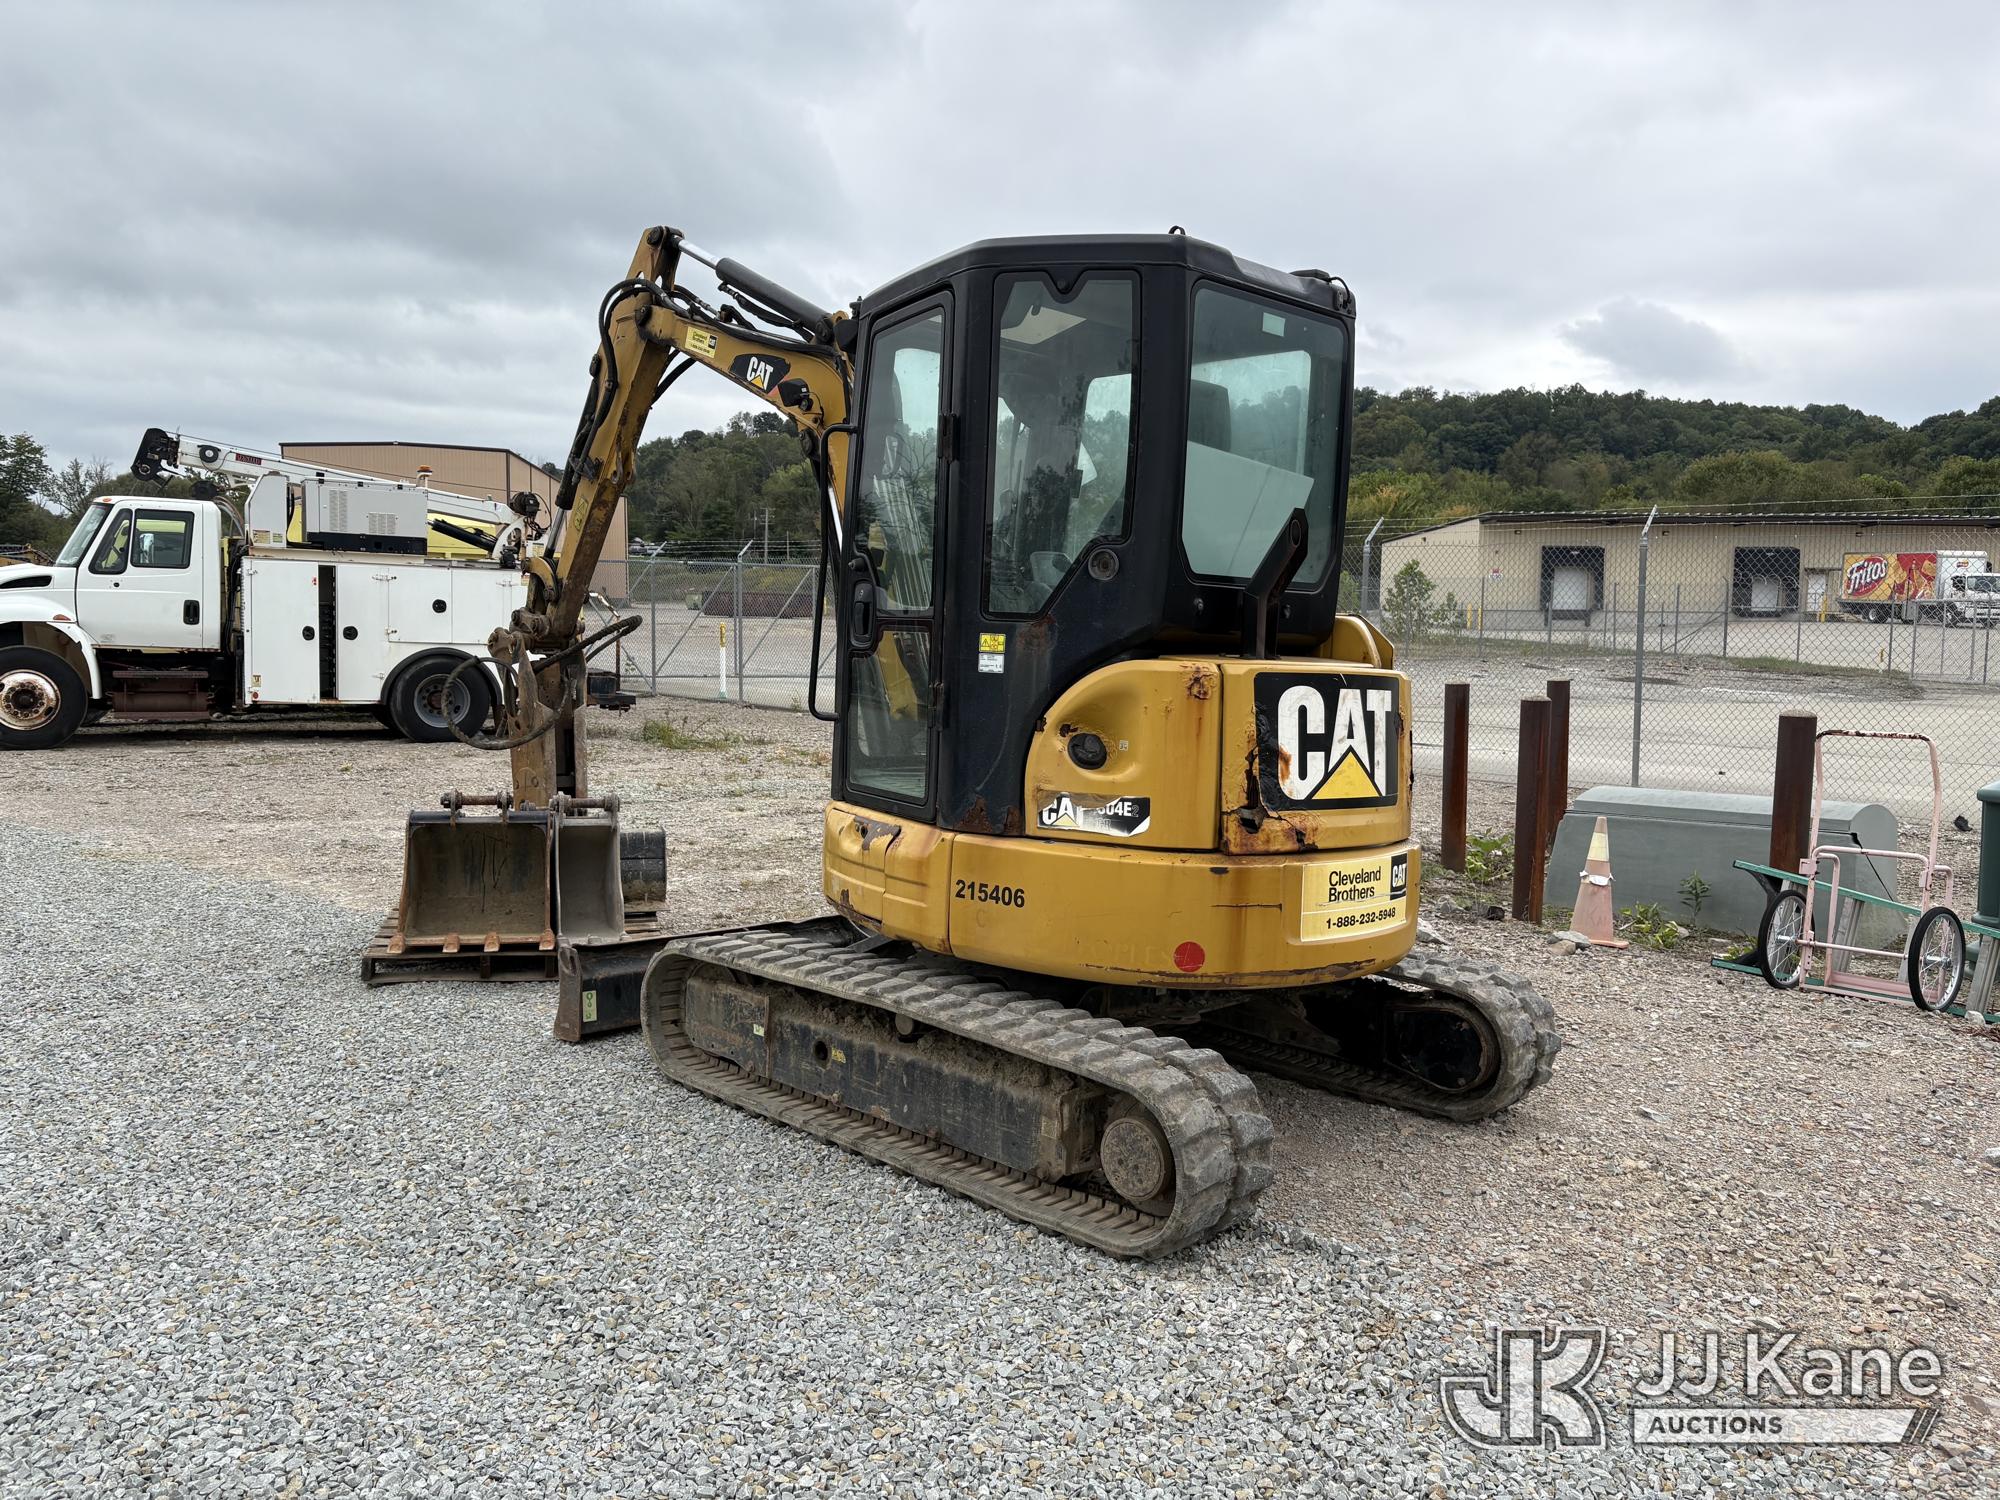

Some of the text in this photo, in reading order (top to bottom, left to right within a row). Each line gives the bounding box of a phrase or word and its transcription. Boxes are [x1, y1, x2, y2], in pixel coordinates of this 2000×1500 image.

[746, 356, 774, 390] CAT
[1846, 559, 1888, 594] Fritos
[1277, 685, 1392, 800] CAT
[1329, 866, 1382, 887] Cleveland
[1392, 863, 1407, 888] CAT
[955, 879, 1025, 908] 215406
[1328, 885, 1375, 903] Brothers
[1326, 907, 1396, 929] 1-888-232-5948
